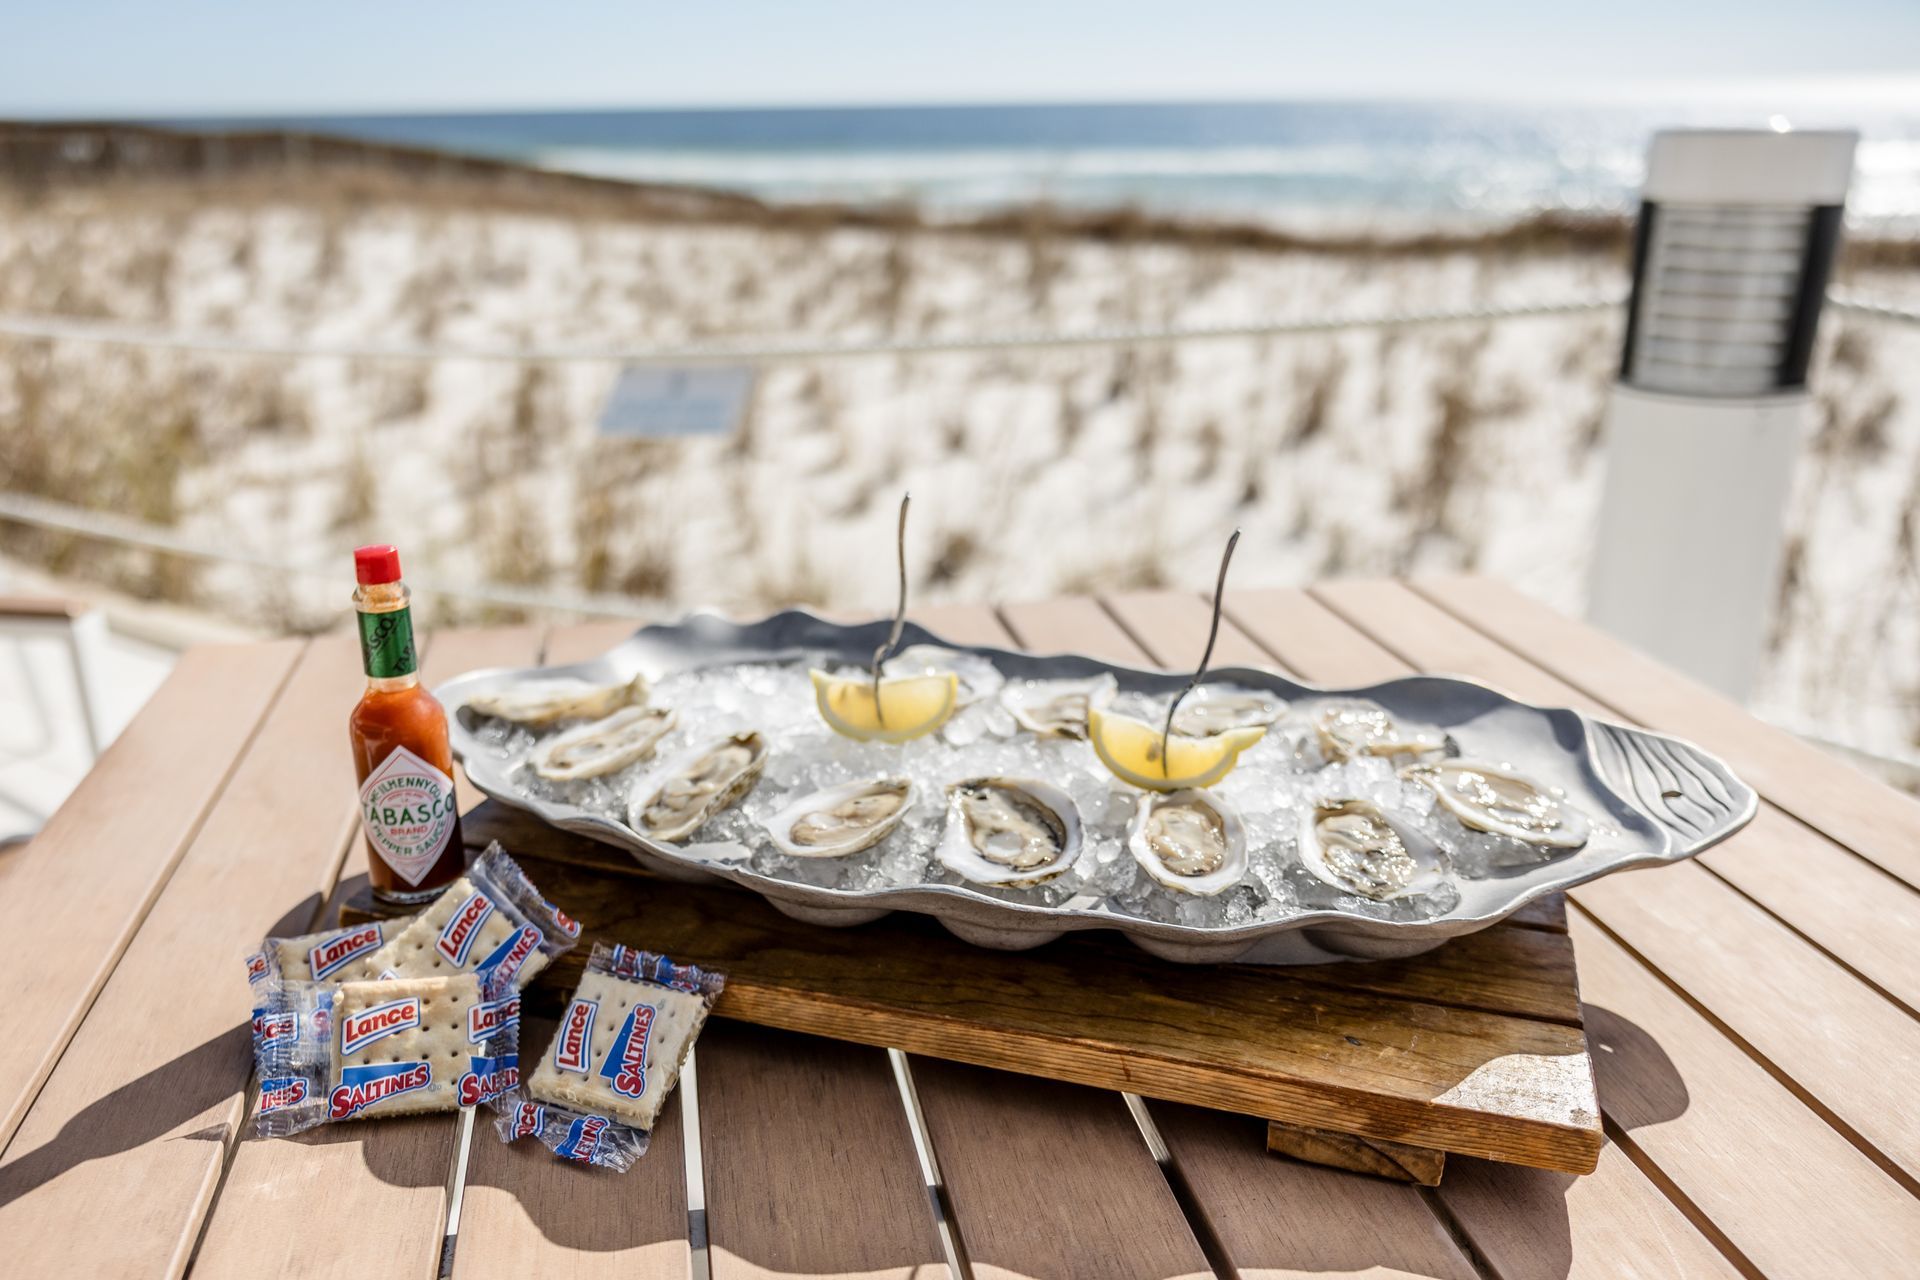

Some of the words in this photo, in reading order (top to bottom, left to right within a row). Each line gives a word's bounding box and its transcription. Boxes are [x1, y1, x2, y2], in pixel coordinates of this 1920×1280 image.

[362, 793, 455, 826] TABASCO
[390, 825, 428, 836] BRAND
[313, 929, 377, 971] Lance
[440, 896, 489, 959] Lance
[346, 1003, 415, 1043] Lance
[559, 1004, 590, 1067] Lance
[616, 1006, 654, 1095] SALTINES
[331, 1066, 428, 1118] SALTINES
